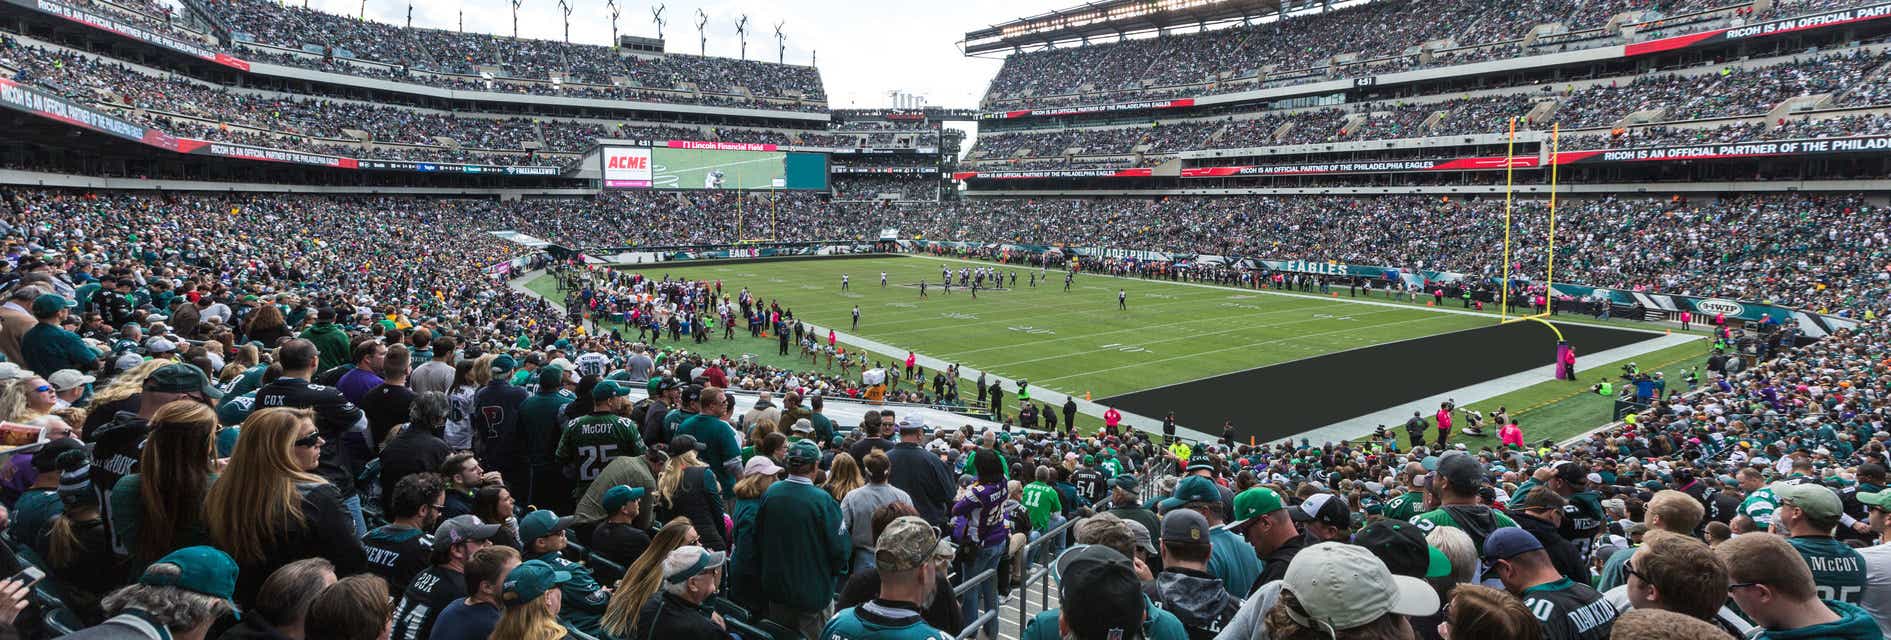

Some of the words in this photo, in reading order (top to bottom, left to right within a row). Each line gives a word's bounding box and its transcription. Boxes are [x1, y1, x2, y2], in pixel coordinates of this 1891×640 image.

[1726, 25, 1762, 39] RICOH
[1763, 23, 1776, 33] IS
[1778, 19, 1796, 31] AN
[1798, 11, 1854, 28] OFFICIAL
[1856, 4, 1891, 18] PART
[38, 0, 62, 14] RICOH
[63, 7, 72, 17] IS
[72, 10, 83, 20] AN
[84, 13, 113, 30] OFFICIAL
[113, 22, 142, 39] PARTNER
[142, 32, 151, 40] OF
[151, 34, 162, 45] THE
[162, 37, 198, 54] PHILADELPHIA
[198, 49, 216, 60] EAGLES
[692, 142, 717, 150] Lincoln
[718, 142, 747, 150] Financial
[748, 143, 764, 151] Field
[1604, 151, 1635, 161] RICOH
[1637, 150, 1648, 159] IS
[1649, 149, 1665, 158] AN
[1667, 147, 1717, 157] OFFICIAL
[1719, 144, 1777, 154] PARTNER
[1779, 142, 1800, 152] OF
[1801, 141, 1829, 151] THE
[1832, 138, 1891, 150] PHILAD
[608, 156, 648, 169] ACME
[1353, 162, 1404, 170] PHILADELPHIA
[729, 248, 760, 257] EAGLS
[1085, 247, 1154, 261] PHILADELPHIA
[1287, 260, 1348, 275] EAGLES
[583, 361, 600, 375] 36
[263, 394, 286, 406] COX
[581, 423, 614, 434] McCOY
[1076, 480, 1095, 498] 54
[1024, 489, 1042, 508] 11
[1809, 556, 1860, 572] McCOY
[414, 572, 441, 593] COX
